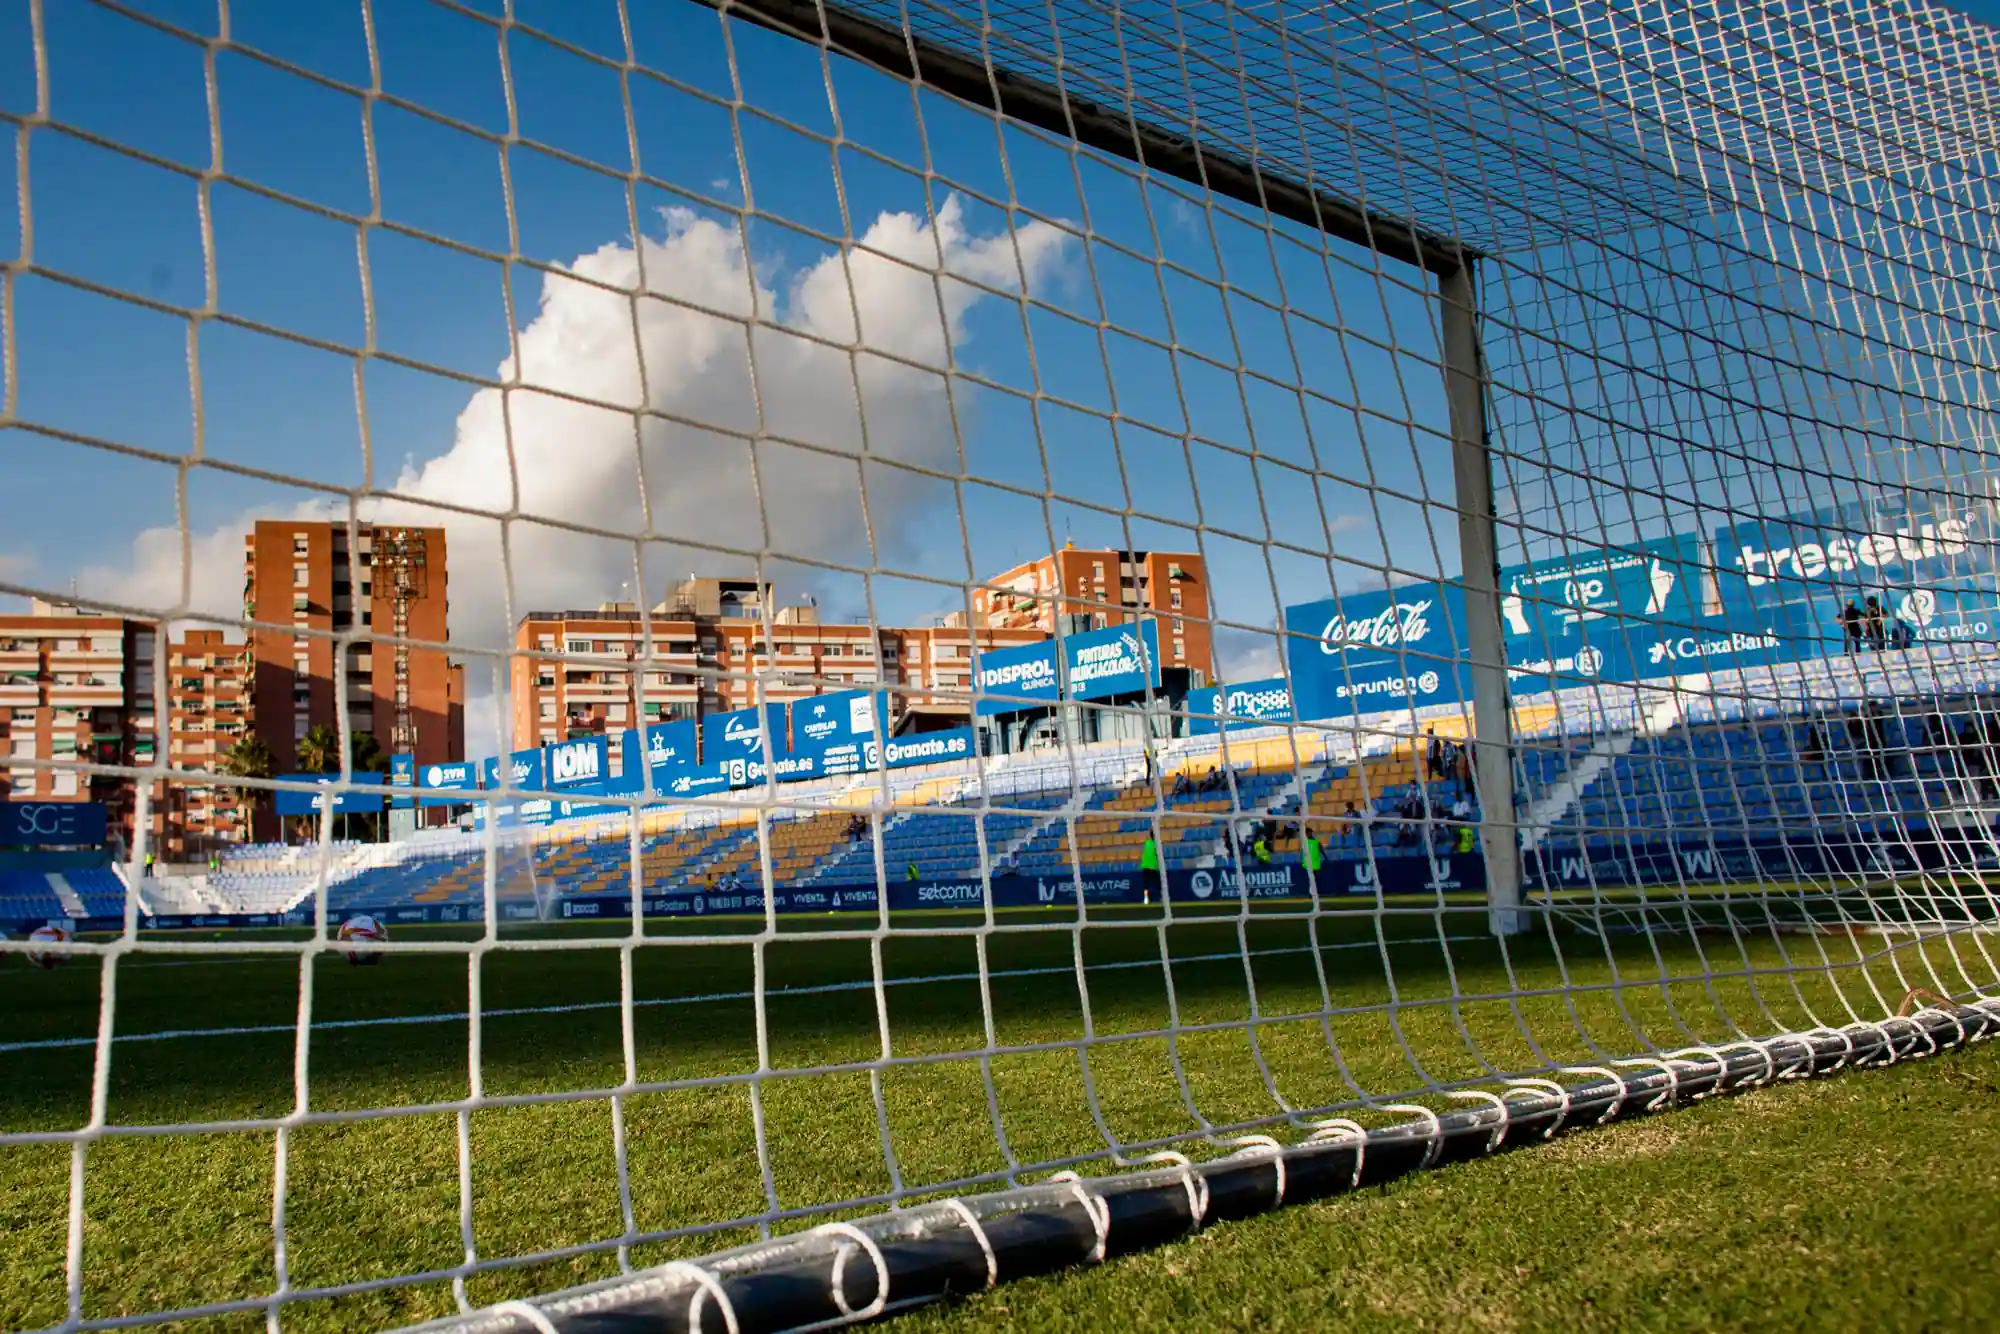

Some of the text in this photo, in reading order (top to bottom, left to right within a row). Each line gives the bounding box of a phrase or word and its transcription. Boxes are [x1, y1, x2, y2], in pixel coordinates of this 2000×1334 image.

[1736, 519, 1969, 587] treseus
[1319, 599, 1433, 655] Coca-Cola
[1676, 627, 1781, 658] CaixaBank
[1336, 674, 1417, 698] serunion
[885, 737, 967, 763] Granate.es
[18, 804, 75, 834] SGE
